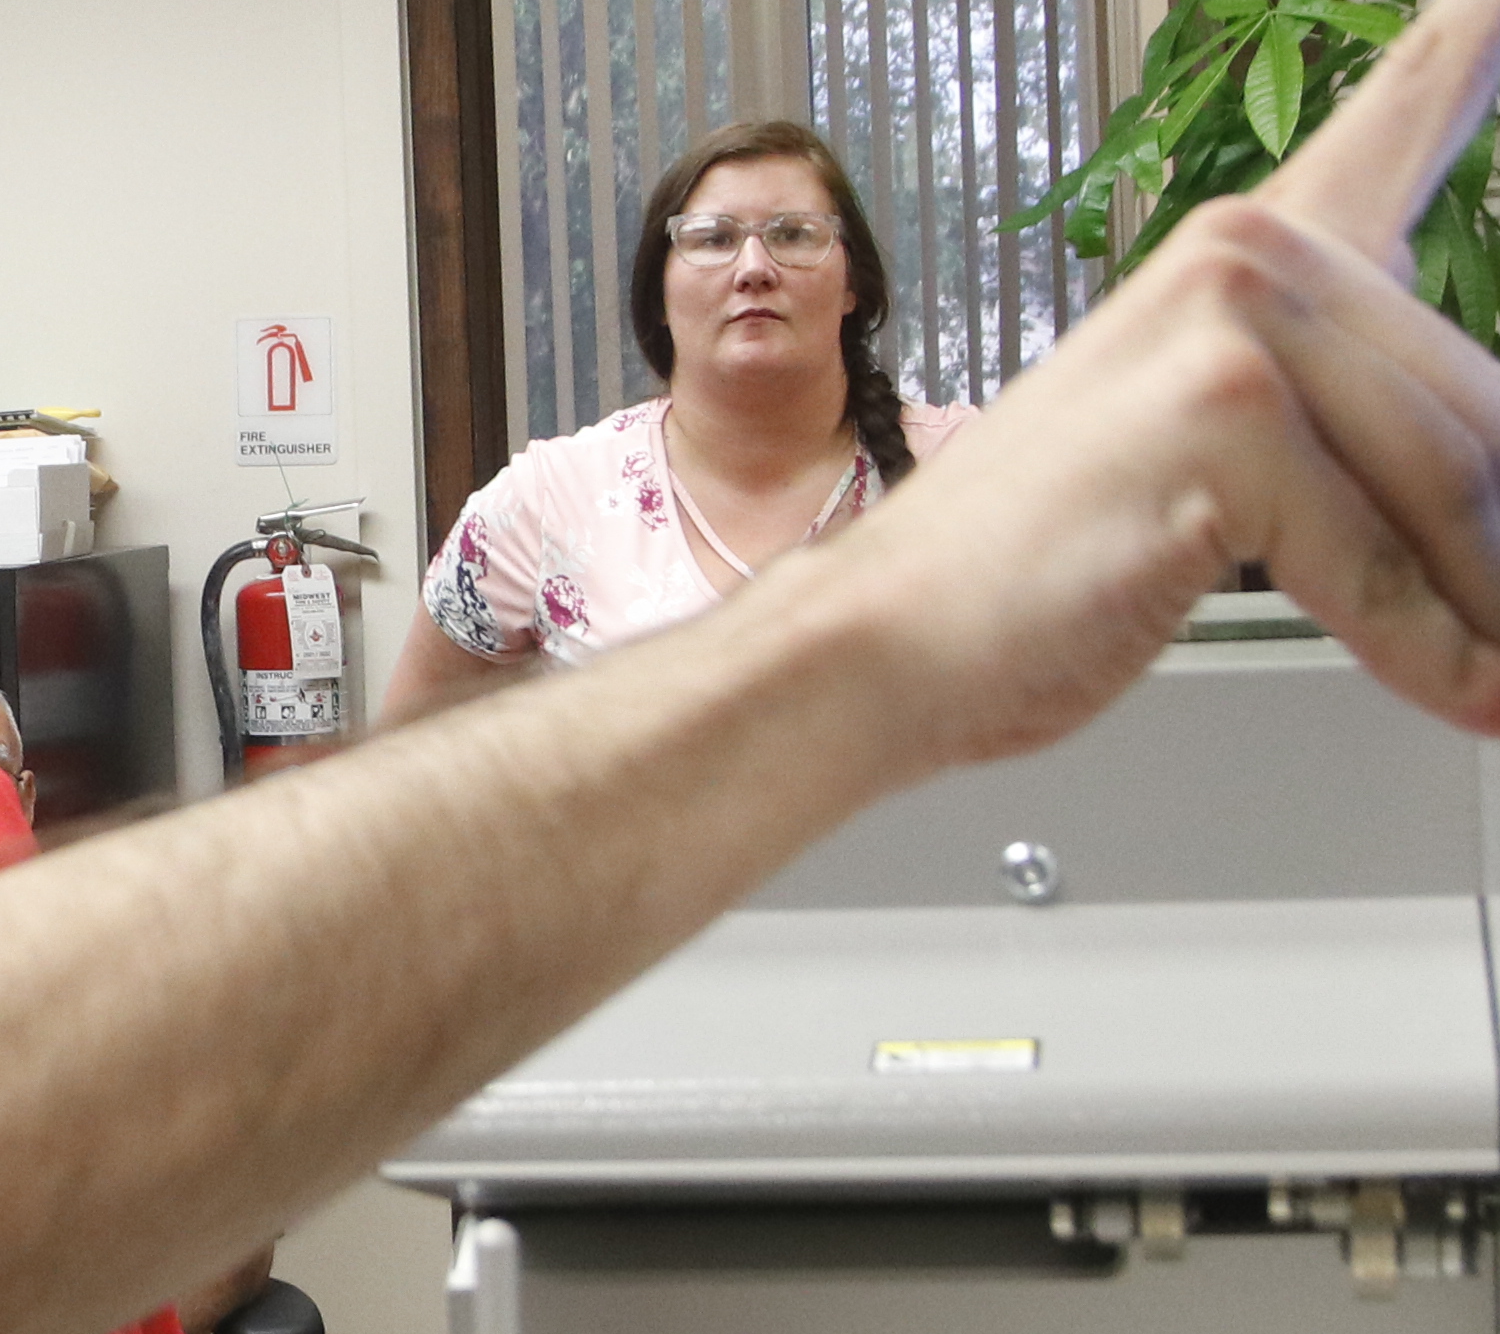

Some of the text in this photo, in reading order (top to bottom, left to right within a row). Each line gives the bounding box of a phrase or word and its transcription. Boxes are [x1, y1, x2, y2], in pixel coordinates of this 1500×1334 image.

[240, 431, 266, 442] FIRE
[240, 443, 331, 455] EXTINGUISHER
[293, 592, 331, 600] MIDWEST
[256, 671, 293, 680] INSTRUC
